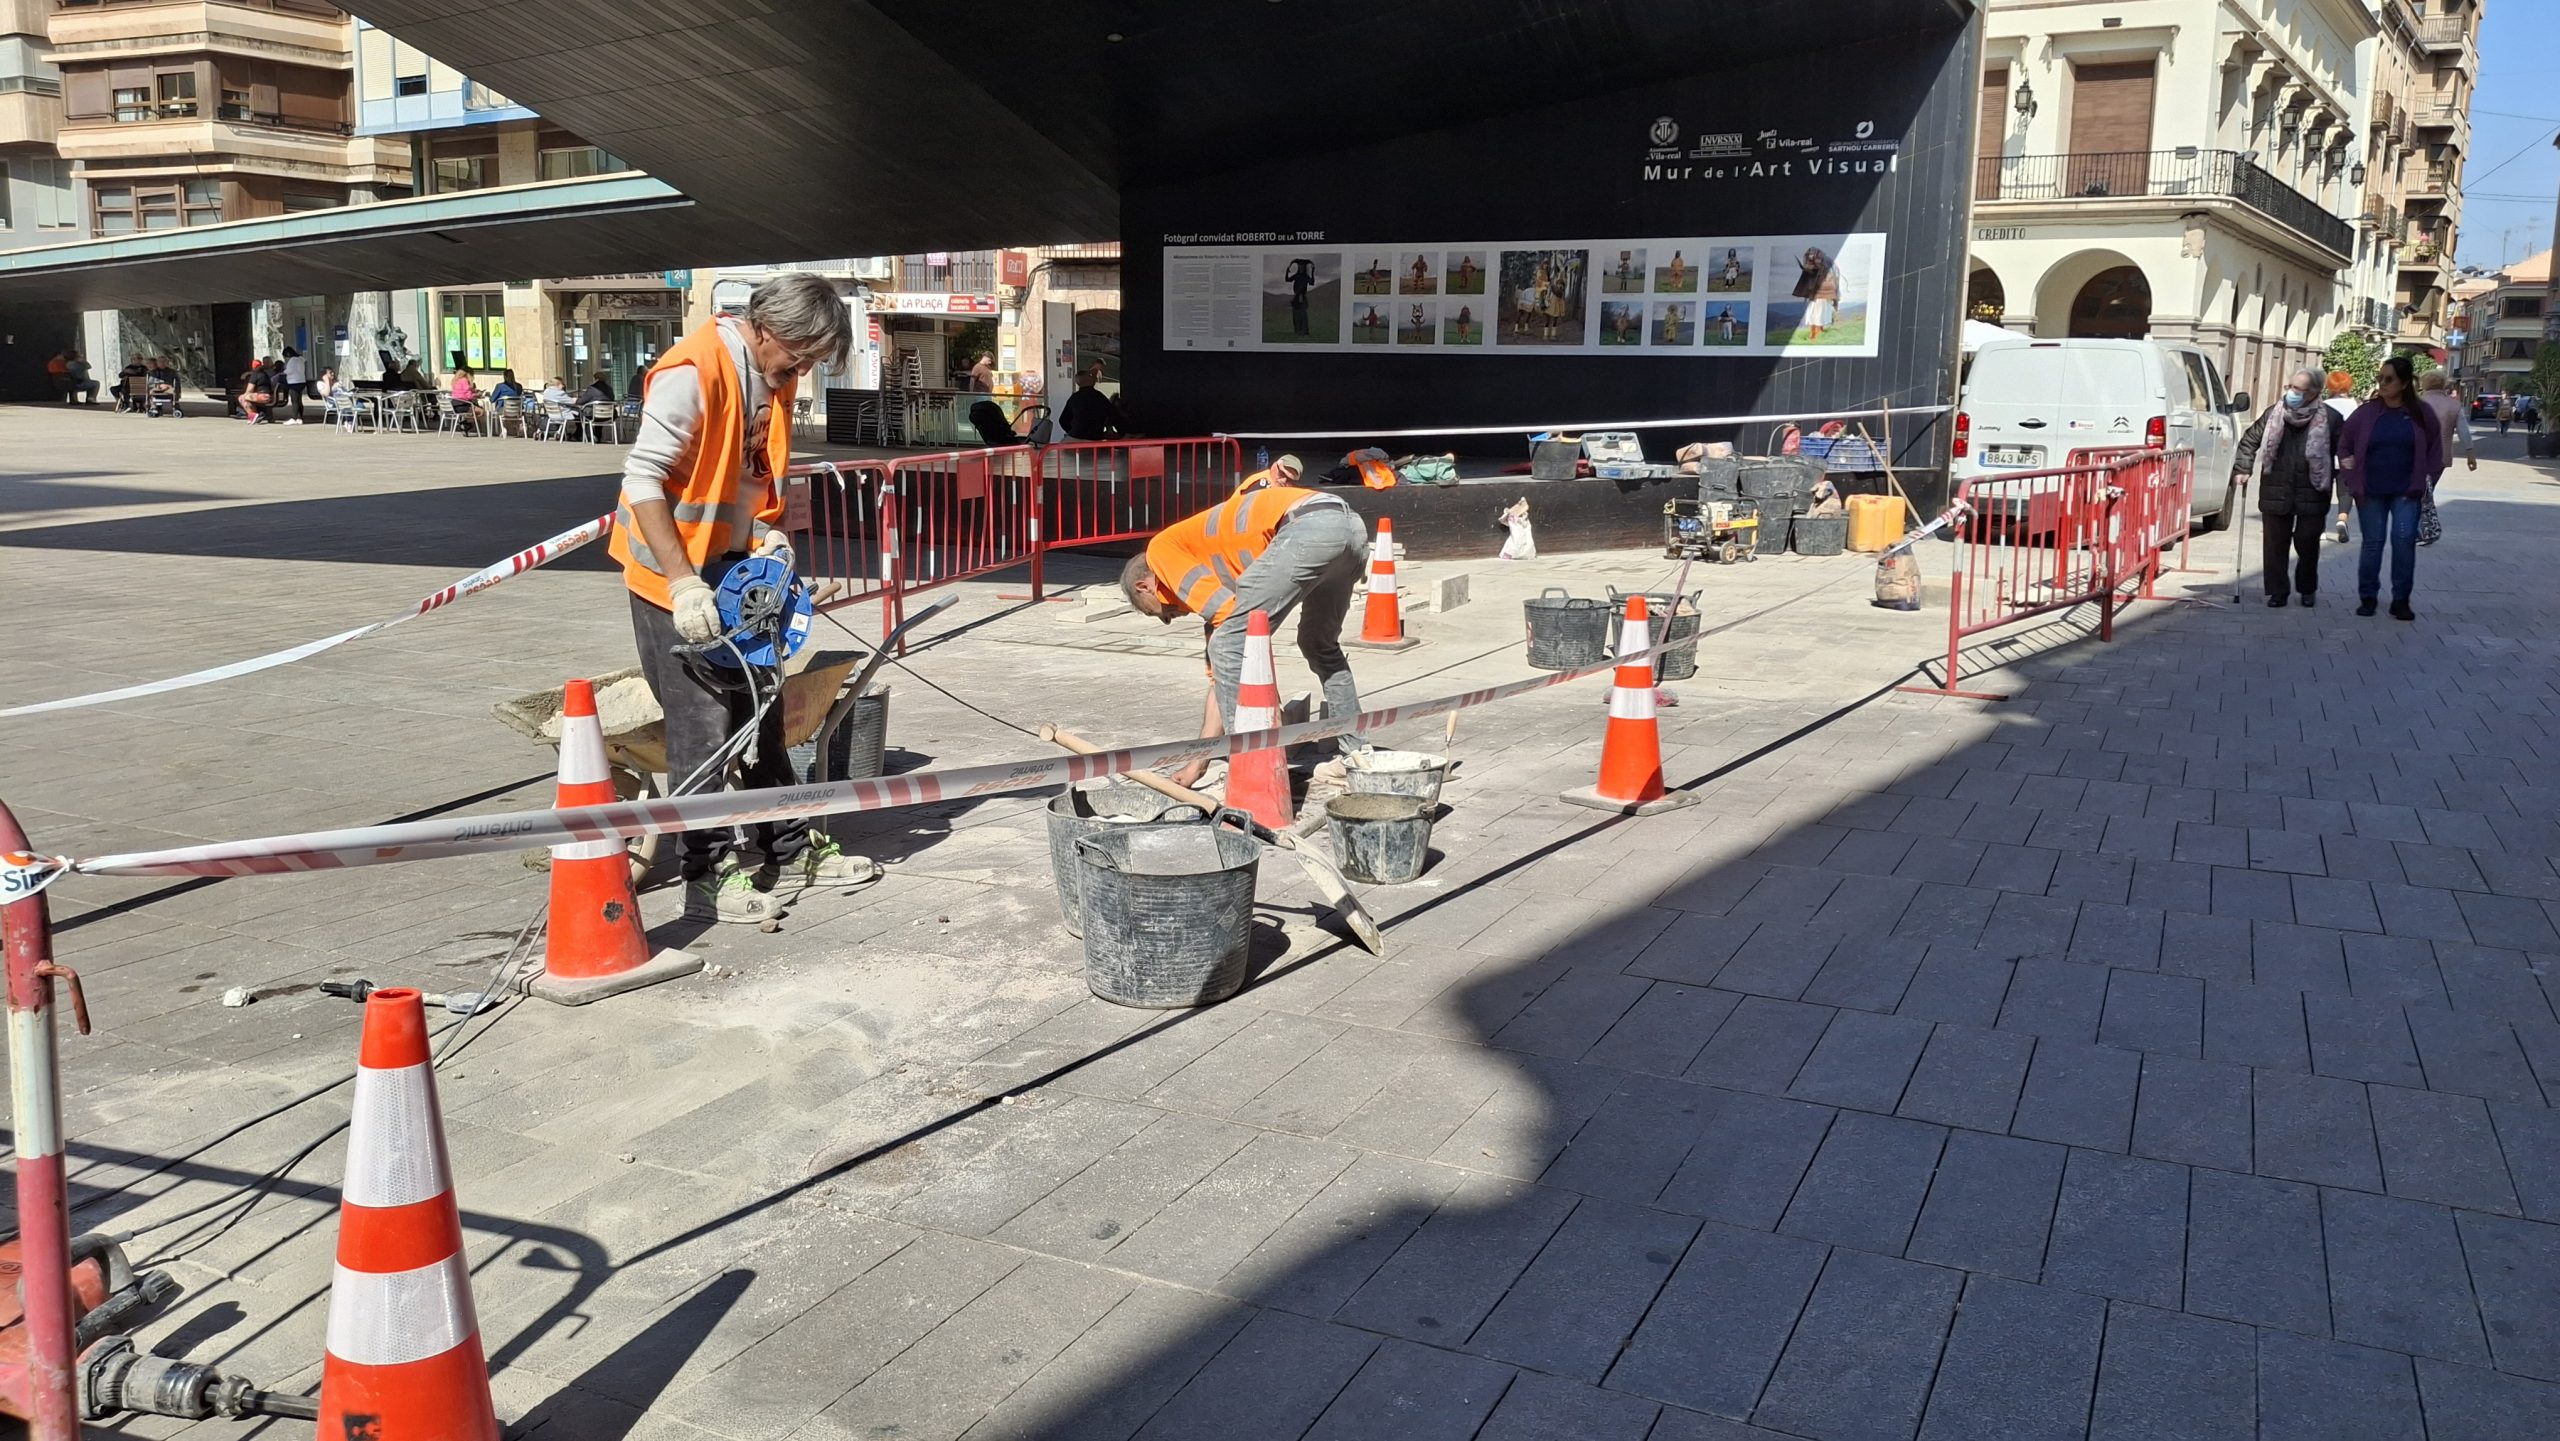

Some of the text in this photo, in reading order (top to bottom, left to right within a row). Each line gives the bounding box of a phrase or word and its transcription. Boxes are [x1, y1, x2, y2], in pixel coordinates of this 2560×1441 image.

[1779, 138, 1813, 148] Vila-real
[1650, 151, 1681, 160] Vila-real
[1644, 165, 1693, 180] Mur
[1704, 167, 1724, 178] de
[1809, 154, 1897, 175] Visual
[1163, 233, 1198, 245] Fotògraf
[1199, 231, 1235, 242] convidat
[1236, 231, 1277, 242] ROBERTO
[1295, 231, 1325, 241] TORRE
[1978, 227, 2026, 240] CREDITO
[901, 298, 943, 311] LA PLAÇA
[1987, 454, 2038, 464] 8843 MPS
